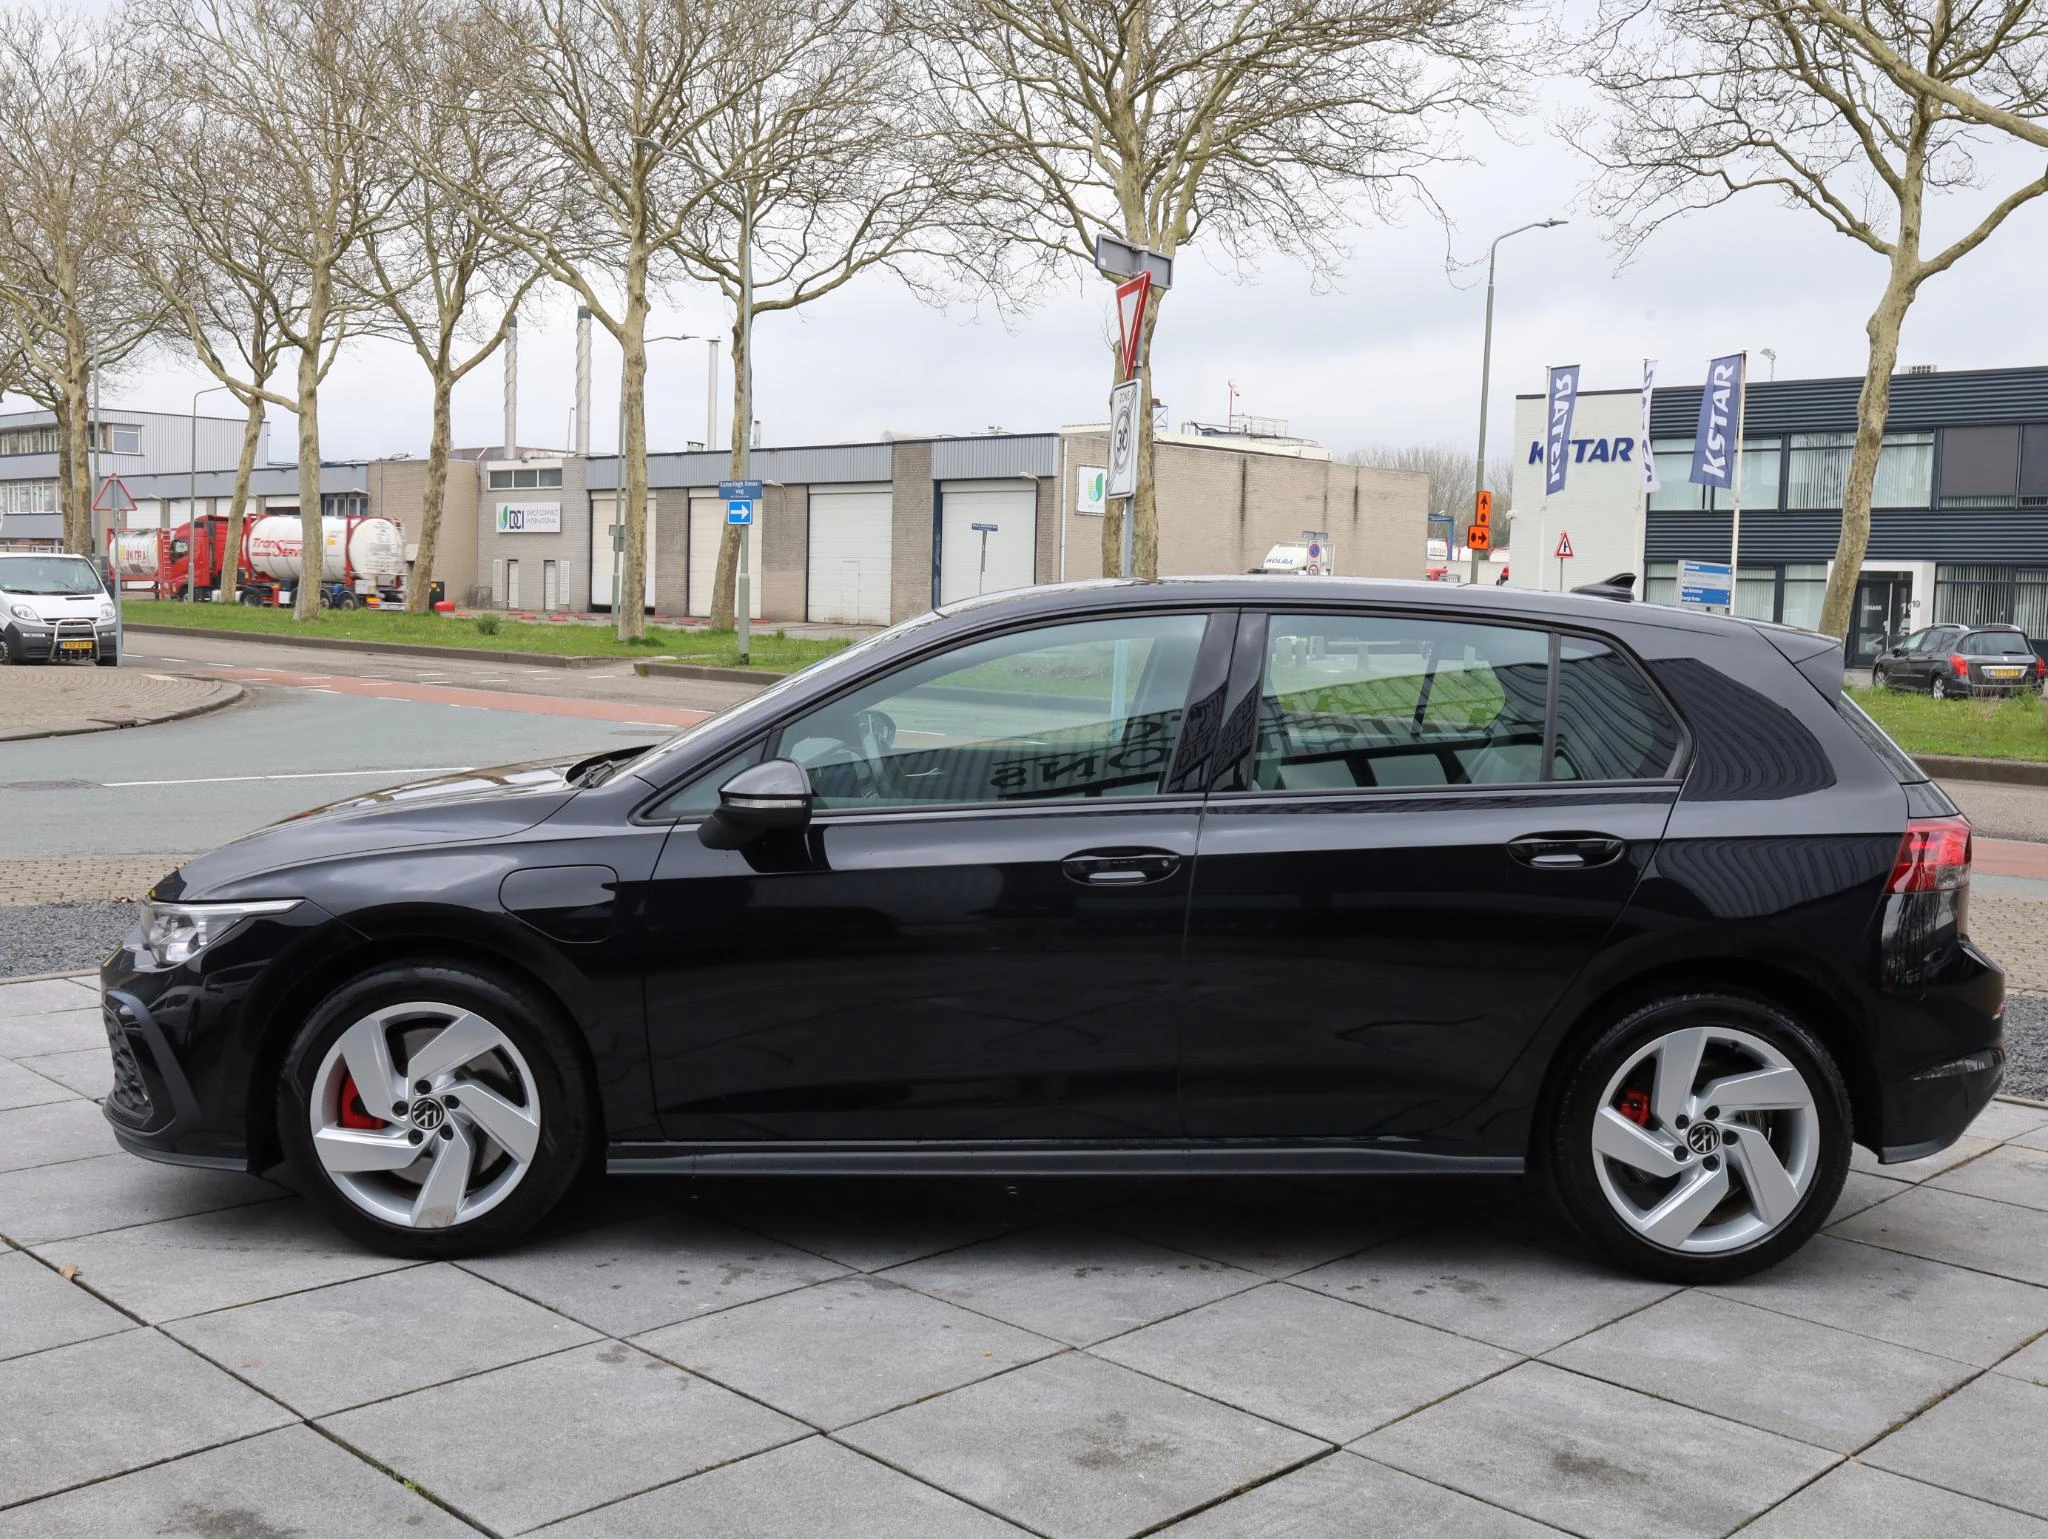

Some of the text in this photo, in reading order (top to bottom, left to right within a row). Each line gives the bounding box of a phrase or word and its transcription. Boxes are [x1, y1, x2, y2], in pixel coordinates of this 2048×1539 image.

[1702, 364, 1734, 479] KSTAR
[1116, 427, 1128, 453] 30
[1528, 437, 1635, 464] KTAR
[509, 510, 525, 530] DCI
